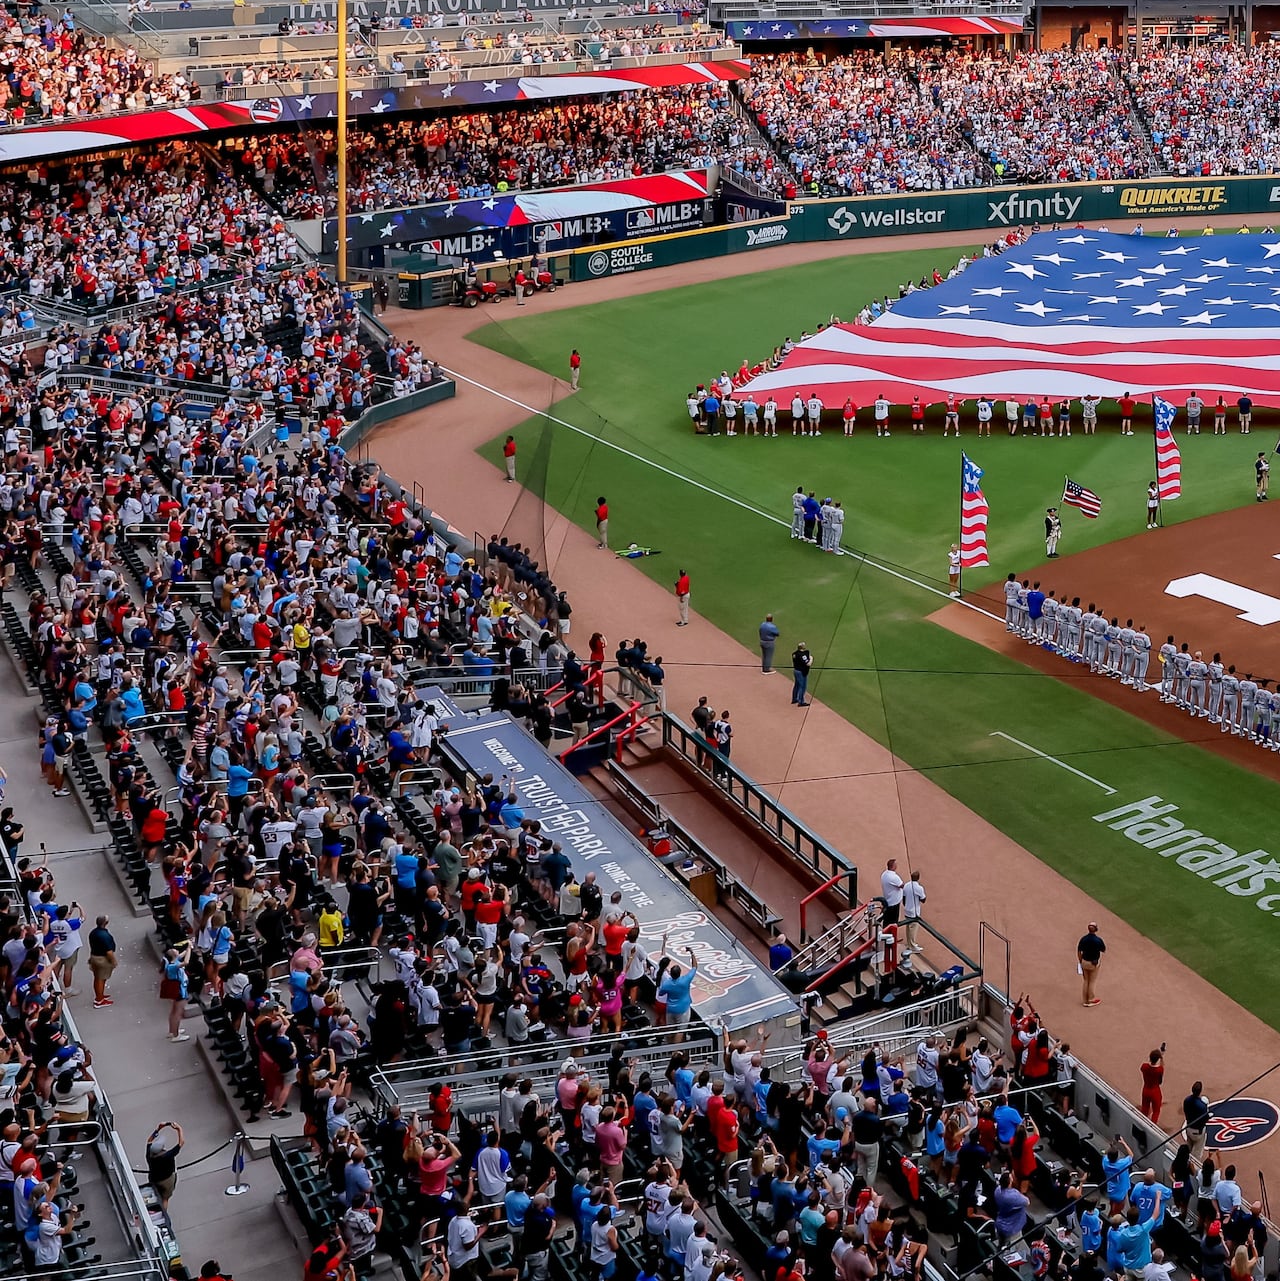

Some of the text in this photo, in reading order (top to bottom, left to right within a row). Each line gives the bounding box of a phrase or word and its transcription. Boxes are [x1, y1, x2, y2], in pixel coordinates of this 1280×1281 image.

[656, 202, 701, 224] MLB+
[860, 208, 946, 228] Wellstar
[988, 192, 1082, 224] xfinity
[1149, 206, 1184, 214] America's
[1186, 205, 1206, 213] Made
[444, 235, 495, 256] MLB+
[611, 245, 644, 258] SOUTH
[611, 253, 653, 268] COLLEGE
[482, 738, 525, 774] WELCOME TO
[515, 774, 612, 862] TRUIST PARK
[601, 861, 656, 908] HOME OF THE
[1139, 1198, 1153, 1210] 27
